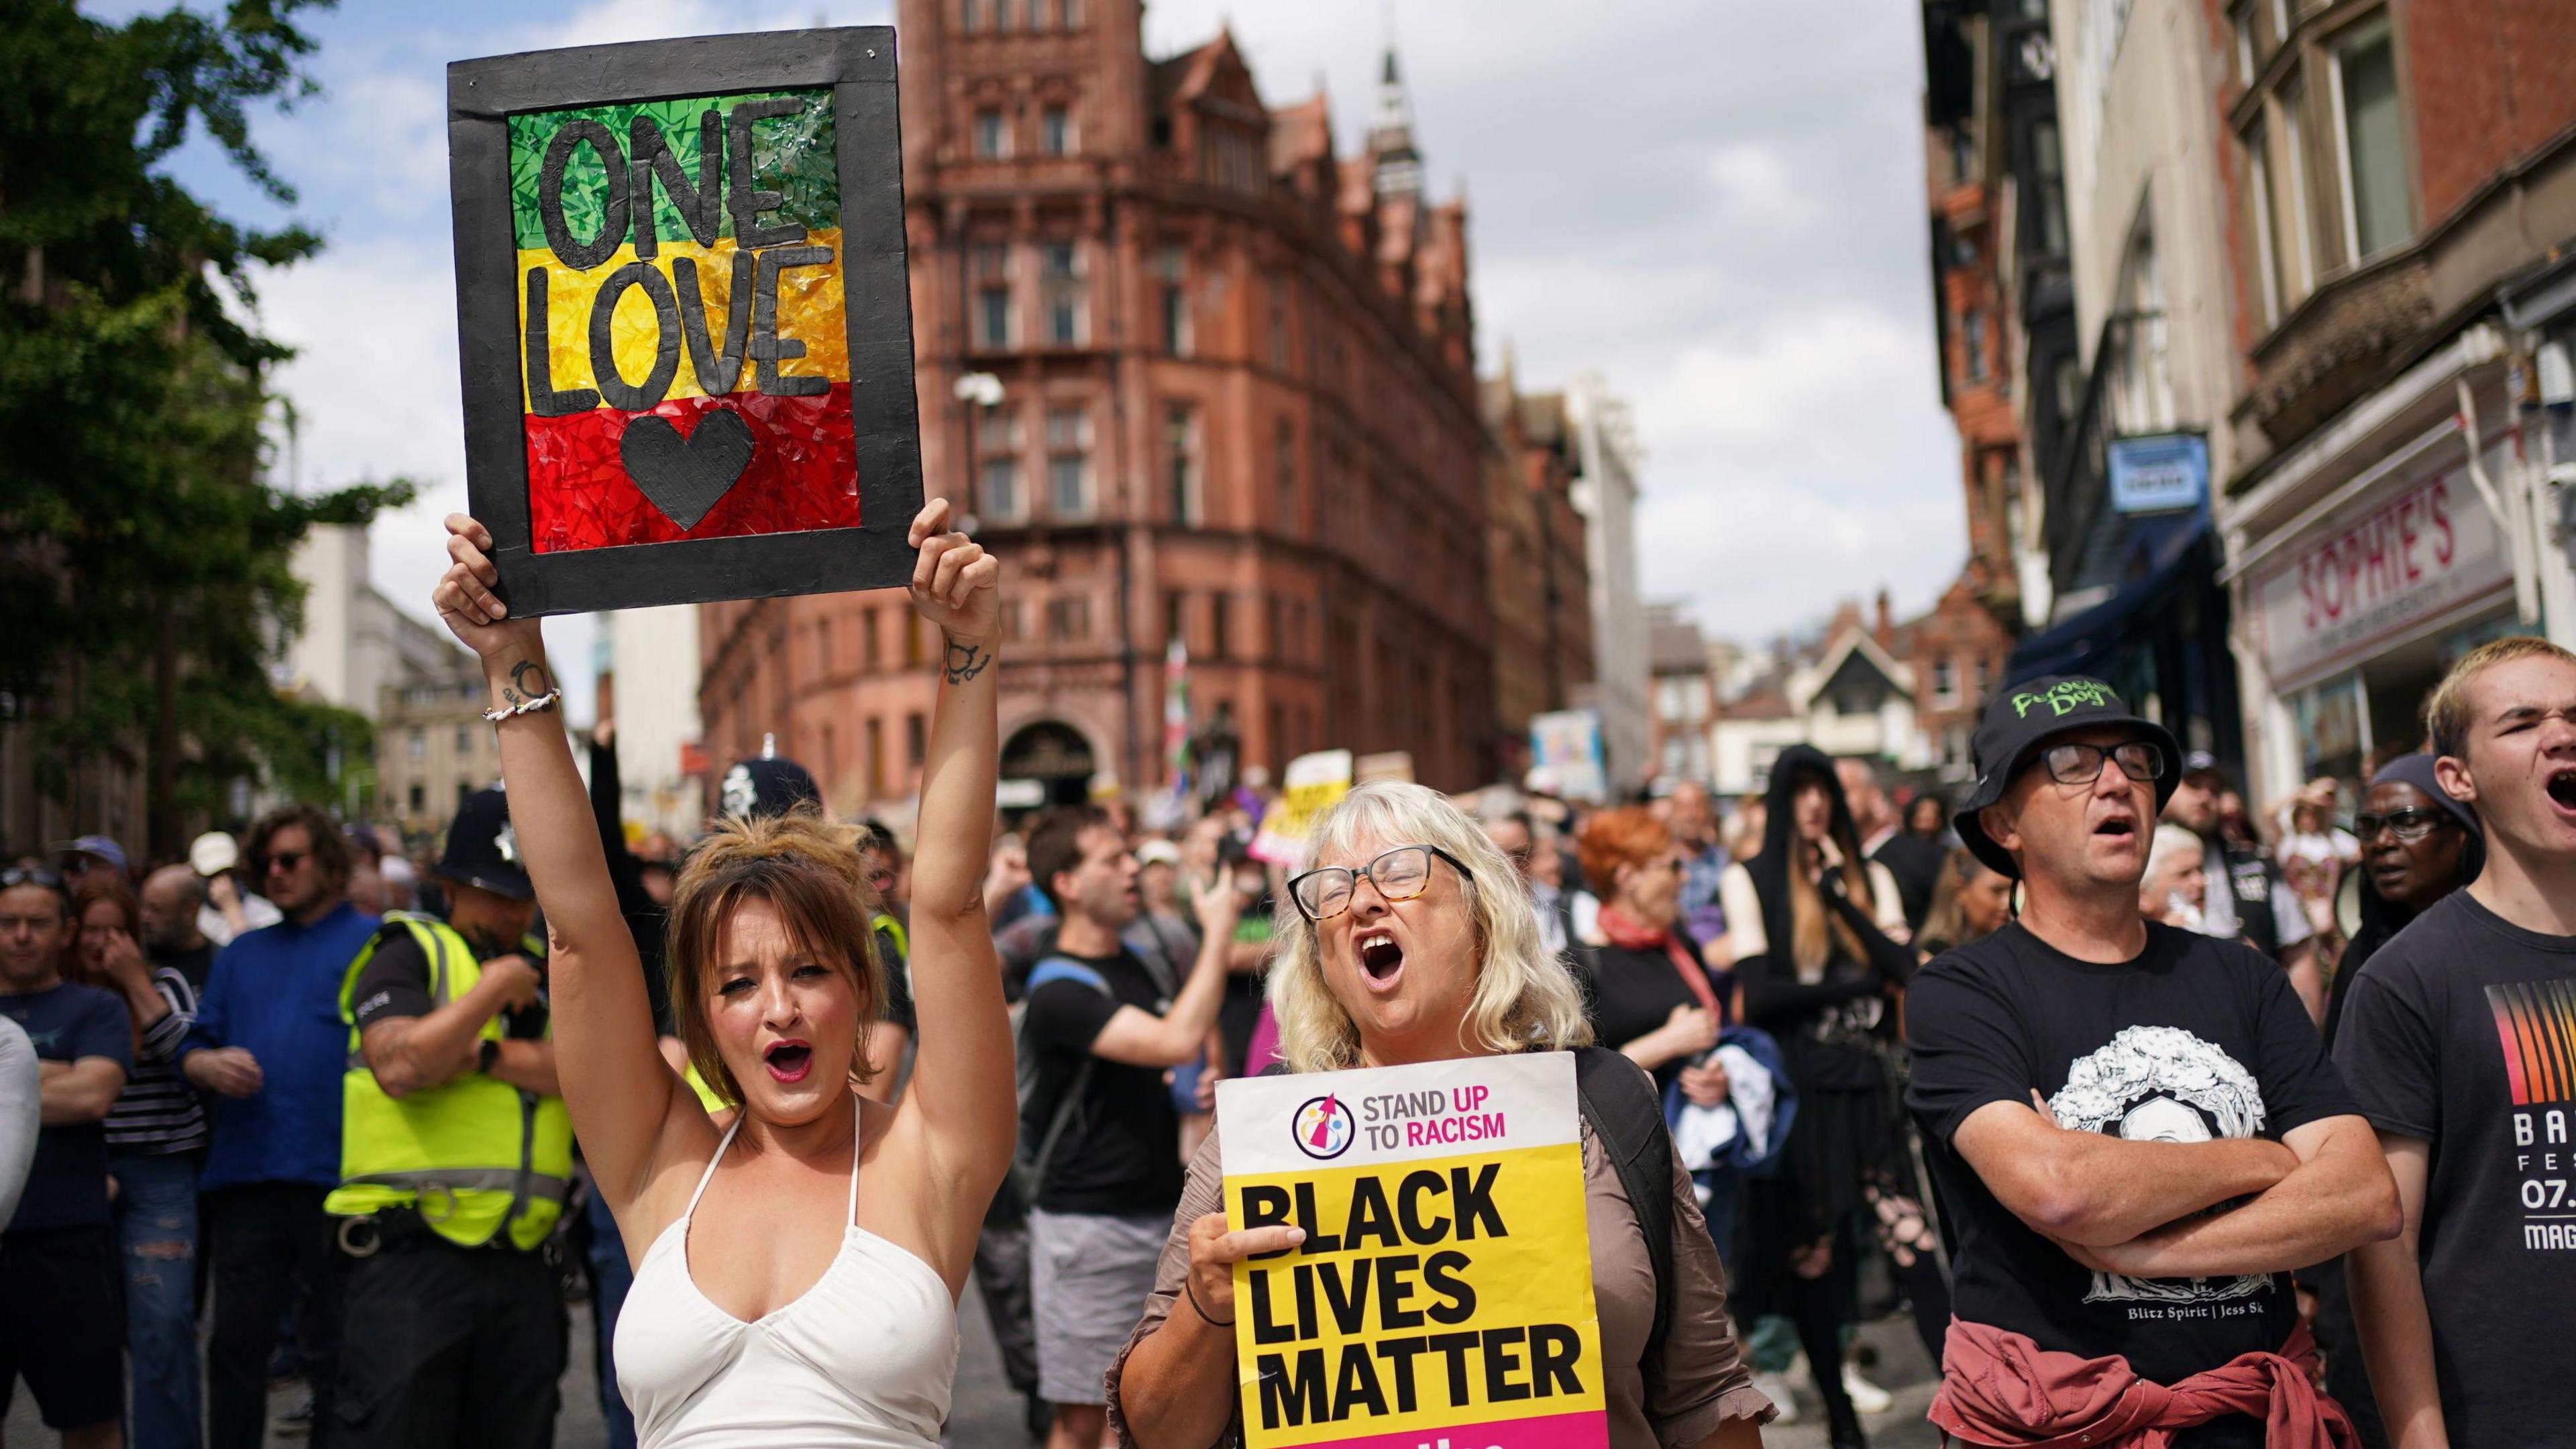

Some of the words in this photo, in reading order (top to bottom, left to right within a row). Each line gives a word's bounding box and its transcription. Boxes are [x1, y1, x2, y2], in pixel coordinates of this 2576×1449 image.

[541, 97, 805, 272] ONE
[526, 246, 835, 417] LOVE
[2299, 476, 2455, 629] SOPHIE'S
[2047, 690, 2105, 716] Dog
[1362, 1090, 1446, 1122] STAND
[1453, 1085, 1489, 1112] UP
[1364, 1124, 1399, 1151] TO
[1407, 1112, 1505, 1147] RACISM
[2514, 1110, 2576, 1146] BA
[1241, 1163, 1508, 1260] BLACK
[1249, 1250, 1477, 1345] LIVES
[2128, 1307, 2163, 1320] Blitz
[2167, 1307, 2208, 1321] Spirit
[2221, 1305, 2245, 1318] Jess
[1256, 1323, 1585, 1430] MATTER
